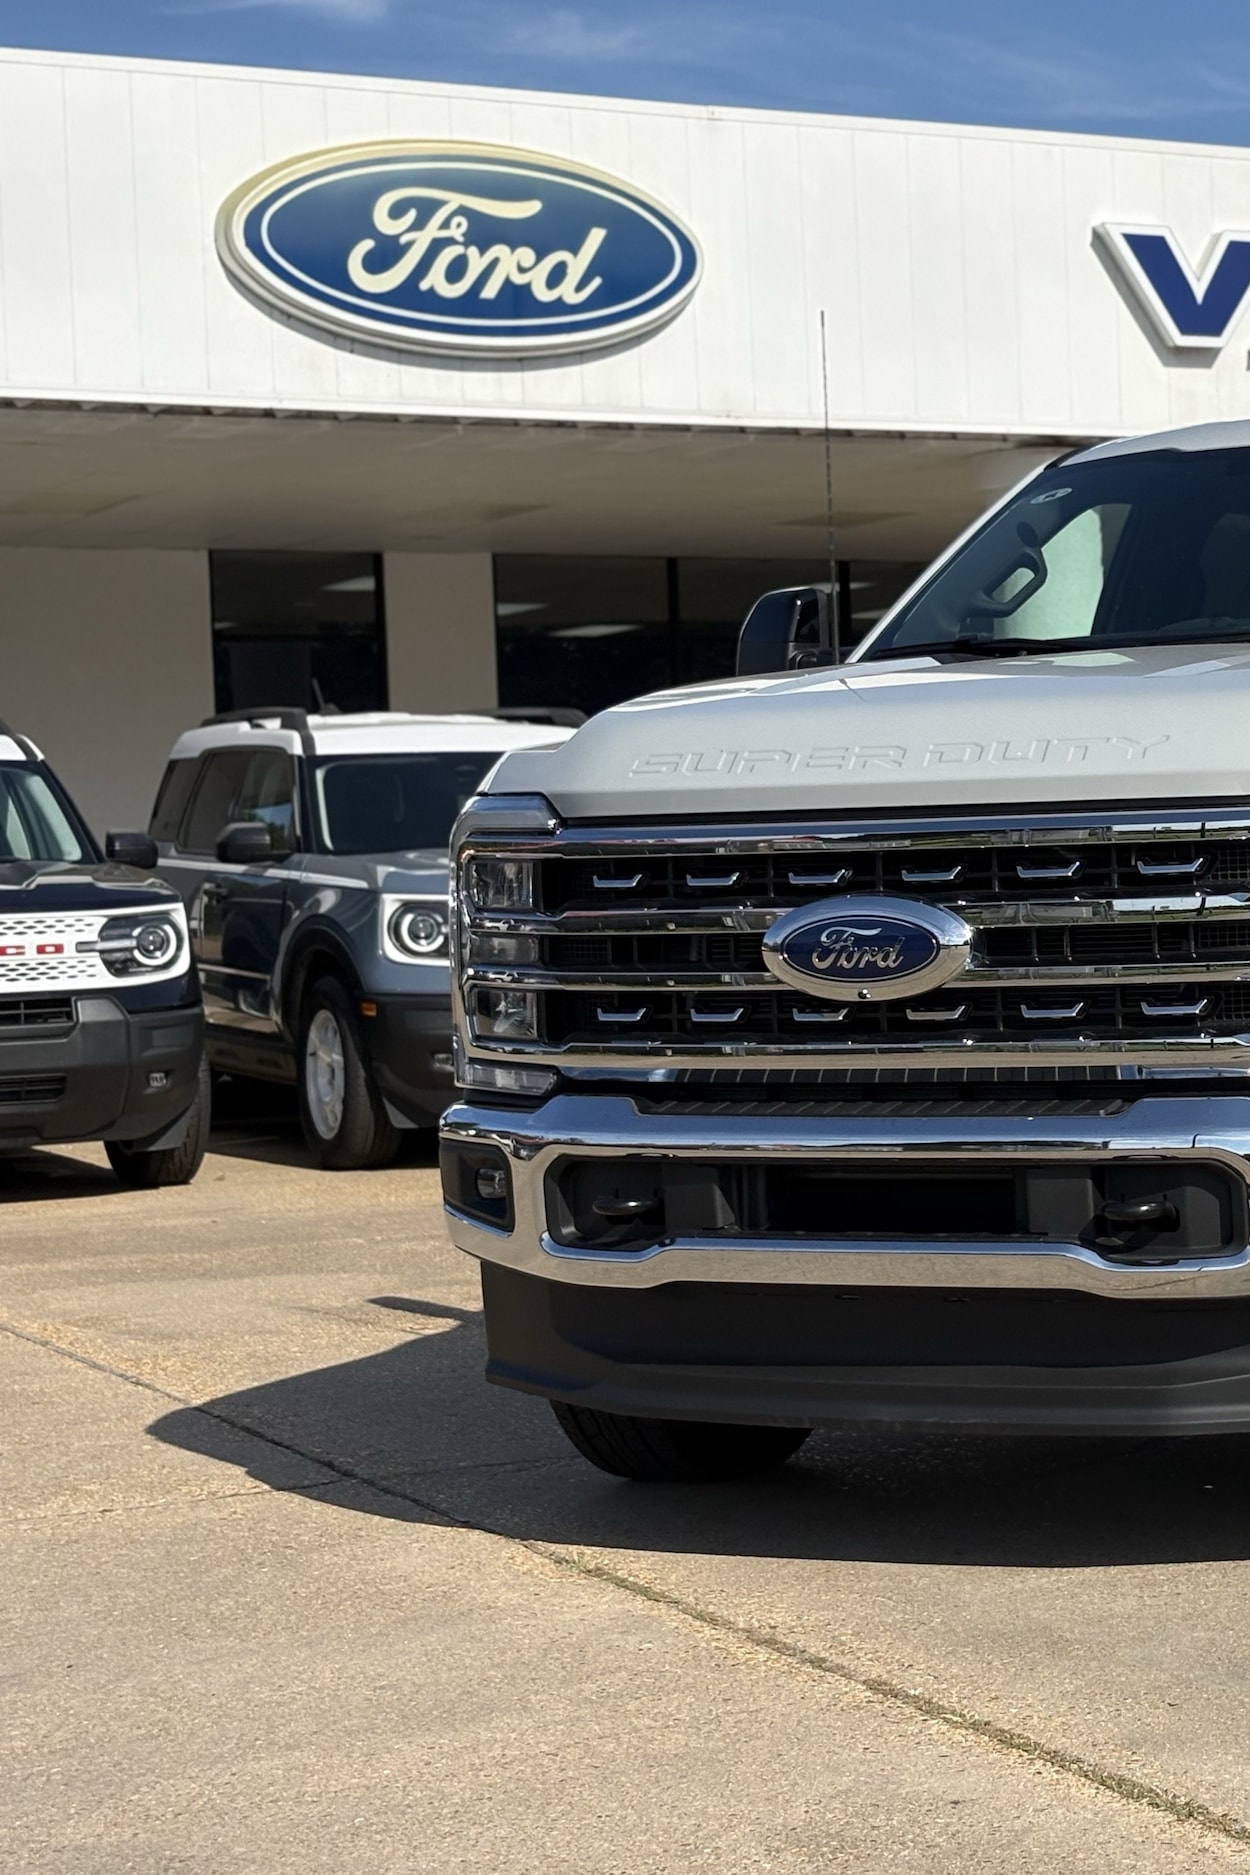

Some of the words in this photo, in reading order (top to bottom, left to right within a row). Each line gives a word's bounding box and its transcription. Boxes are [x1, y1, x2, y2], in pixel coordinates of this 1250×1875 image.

[346, 186, 607, 305] Ford
[628, 744, 907, 779] SUPER
[922, 734, 1171, 768] DUTY
[811, 926, 906, 970] Ford
